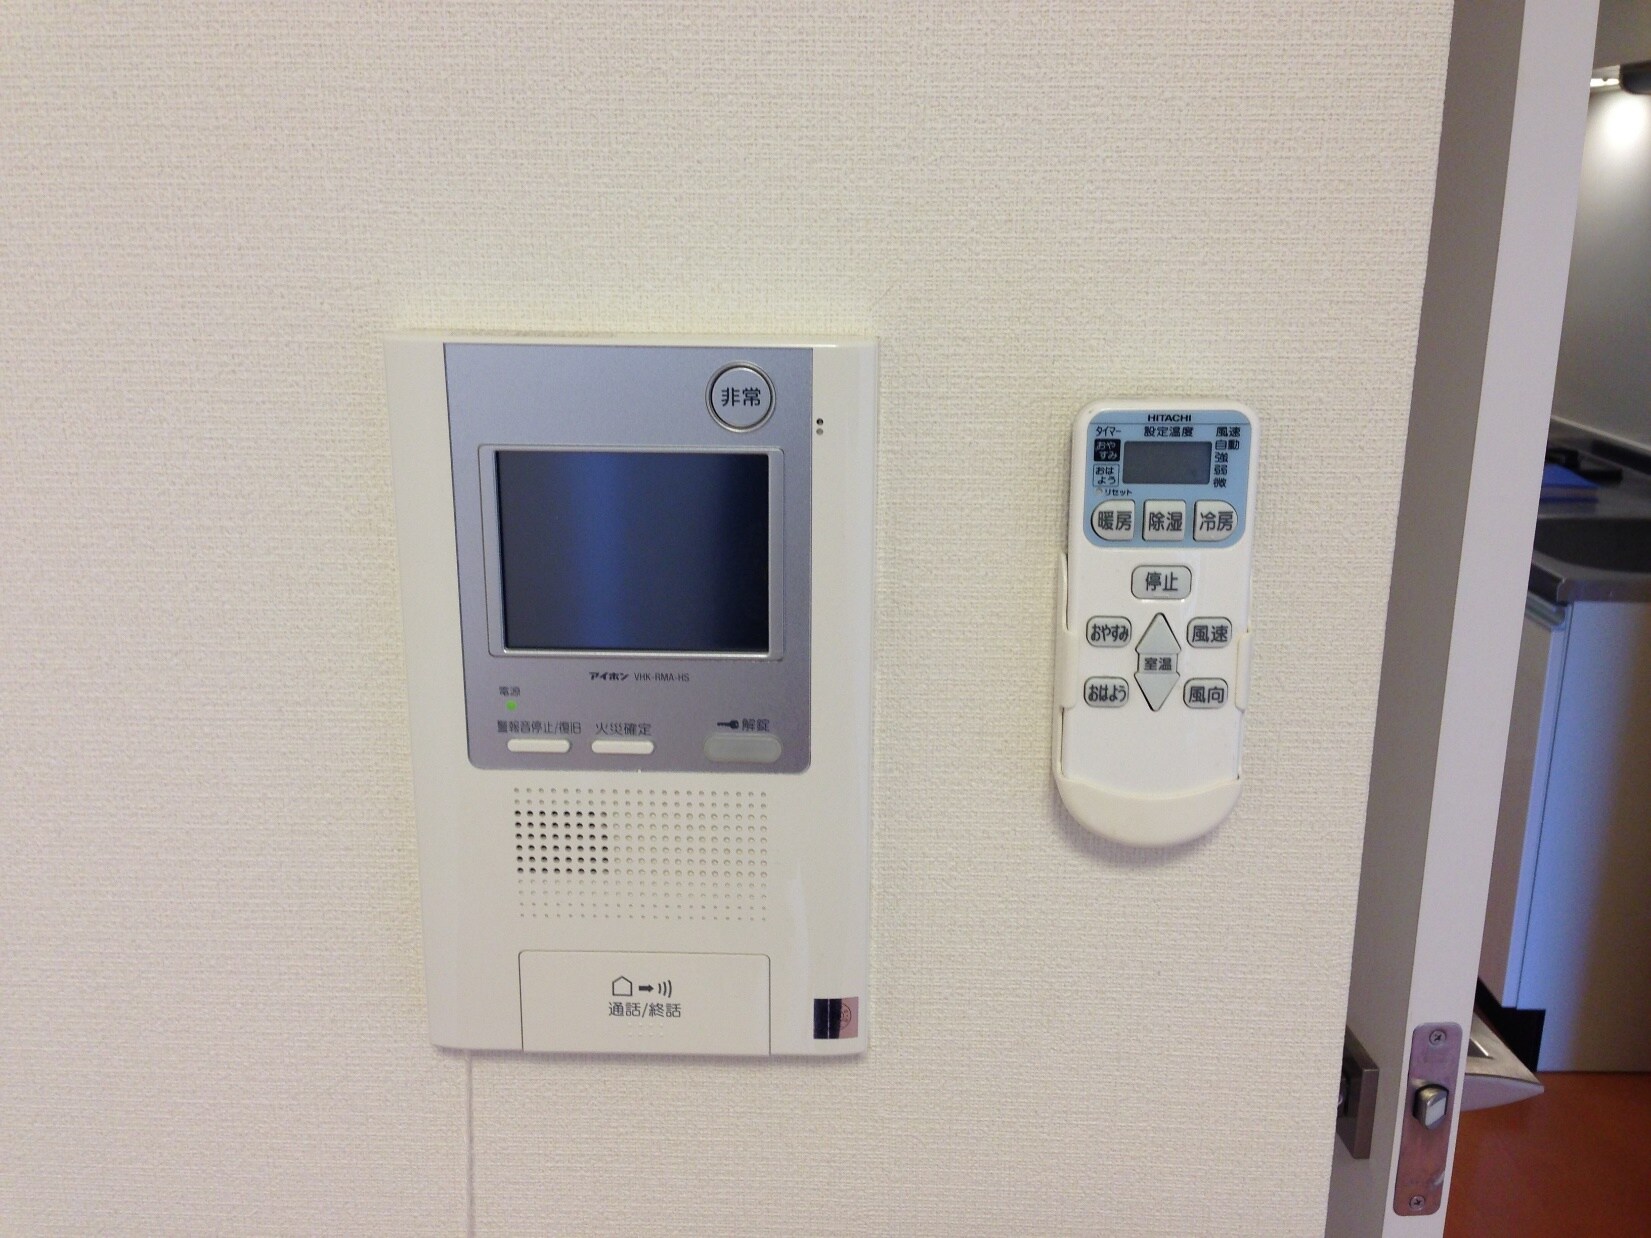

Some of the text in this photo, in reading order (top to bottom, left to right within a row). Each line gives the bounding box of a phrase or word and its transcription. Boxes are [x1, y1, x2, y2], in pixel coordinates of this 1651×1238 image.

[721, 387, 761, 407] 非常
[1147, 414, 1192, 422] HITACHI
[1095, 426, 1122, 437] タイマー
[1143, 426, 1194, 438] 設定温度
[1216, 426, 1241, 438] 風速
[1215, 439, 1240, 451] 自動
[1214, 452, 1228, 463] 強
[1213, 464, 1228, 475] 弱
[1213, 477, 1227, 488] 微
[1104, 488, 1133, 496] リセット
[1097, 511, 1132, 531] 暖房
[1149, 511, 1183, 531] 除湿
[1200, 511, 1234, 531] 冷房
[1145, 571, 1179, 591] 停止
[1090, 624, 1129, 642] おやすみ
[1192, 625, 1229, 643] 風速
[1144, 657, 1172, 671] 室温
[589, 672, 690, 682] アイホン VHK-RMA-HS
[499, 686, 521, 697] 電源
[1088, 684, 1127, 702] おはよう
[1188, 686, 1225, 703] 風向
[595, 721, 652, 737] 火災確定
[742, 718, 770, 732] 解錠
[608, 1002, 681, 1018] 通話/終話
